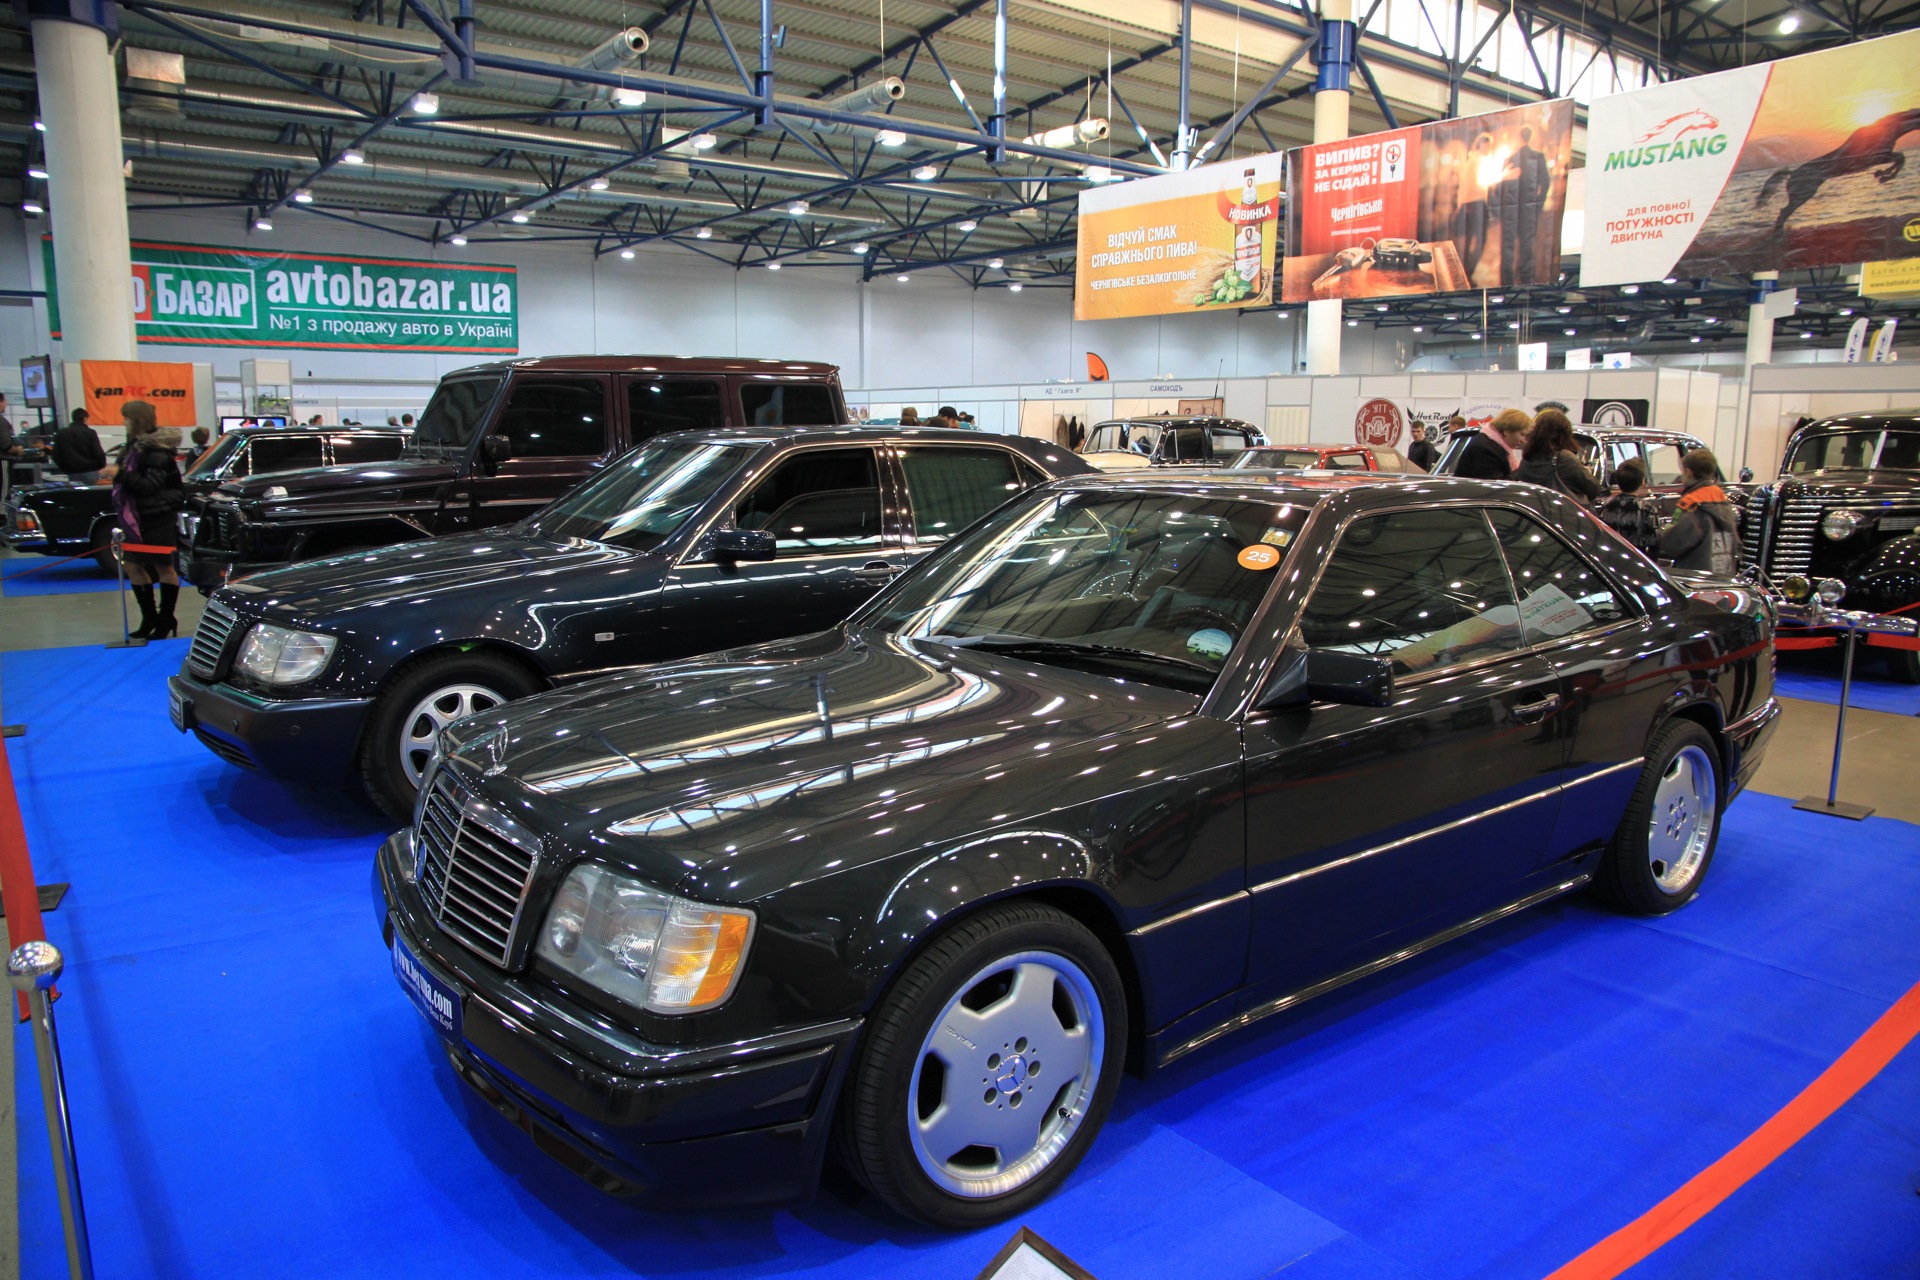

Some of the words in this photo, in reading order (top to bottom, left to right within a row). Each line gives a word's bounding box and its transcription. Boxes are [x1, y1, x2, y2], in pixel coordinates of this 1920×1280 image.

[1315, 143, 1380, 167] ВИПИВ?
[1603, 134, 1728, 172] MUSTANG
[1315, 169, 1329, 180] ЗА
[1331, 162, 1371, 177] КЕРМО
[1314, 181, 1330, 193] НЕ
[1228, 204, 1272, 221] НОВИНКА
[1606, 212, 1694, 232] ПОТУЖНОСТІ
[1108, 226, 1145, 248] ВІДЧУЙ
[1148, 224, 1177, 242] СМАК
[1611, 230, 1663, 244] ДВИГУНА
[1091, 246, 1163, 268] СПРАВЖНЬОГО
[1166, 241, 1198, 258] ПИВА!
[266, 265, 511, 314] avtobazar.ua
[1090, 277, 1135, 290] ЧЕРНІГІВСЬКЕ
[1137, 269, 1198, 286] БЕЗАЛКОГОЛЬНЕ
[155, 272, 249, 318] БАЗАР
[307, 319, 318, 331] з
[322, 319, 397, 337] продажу
[402, 322, 439, 335] авто
[444, 326, 454, 336] в
[457, 321, 512, 340] Україні
[94, 386, 186, 399] fanRC.com
[1413, 411, 1432, 421] Hot
[1245, 550, 1271, 563] 25
